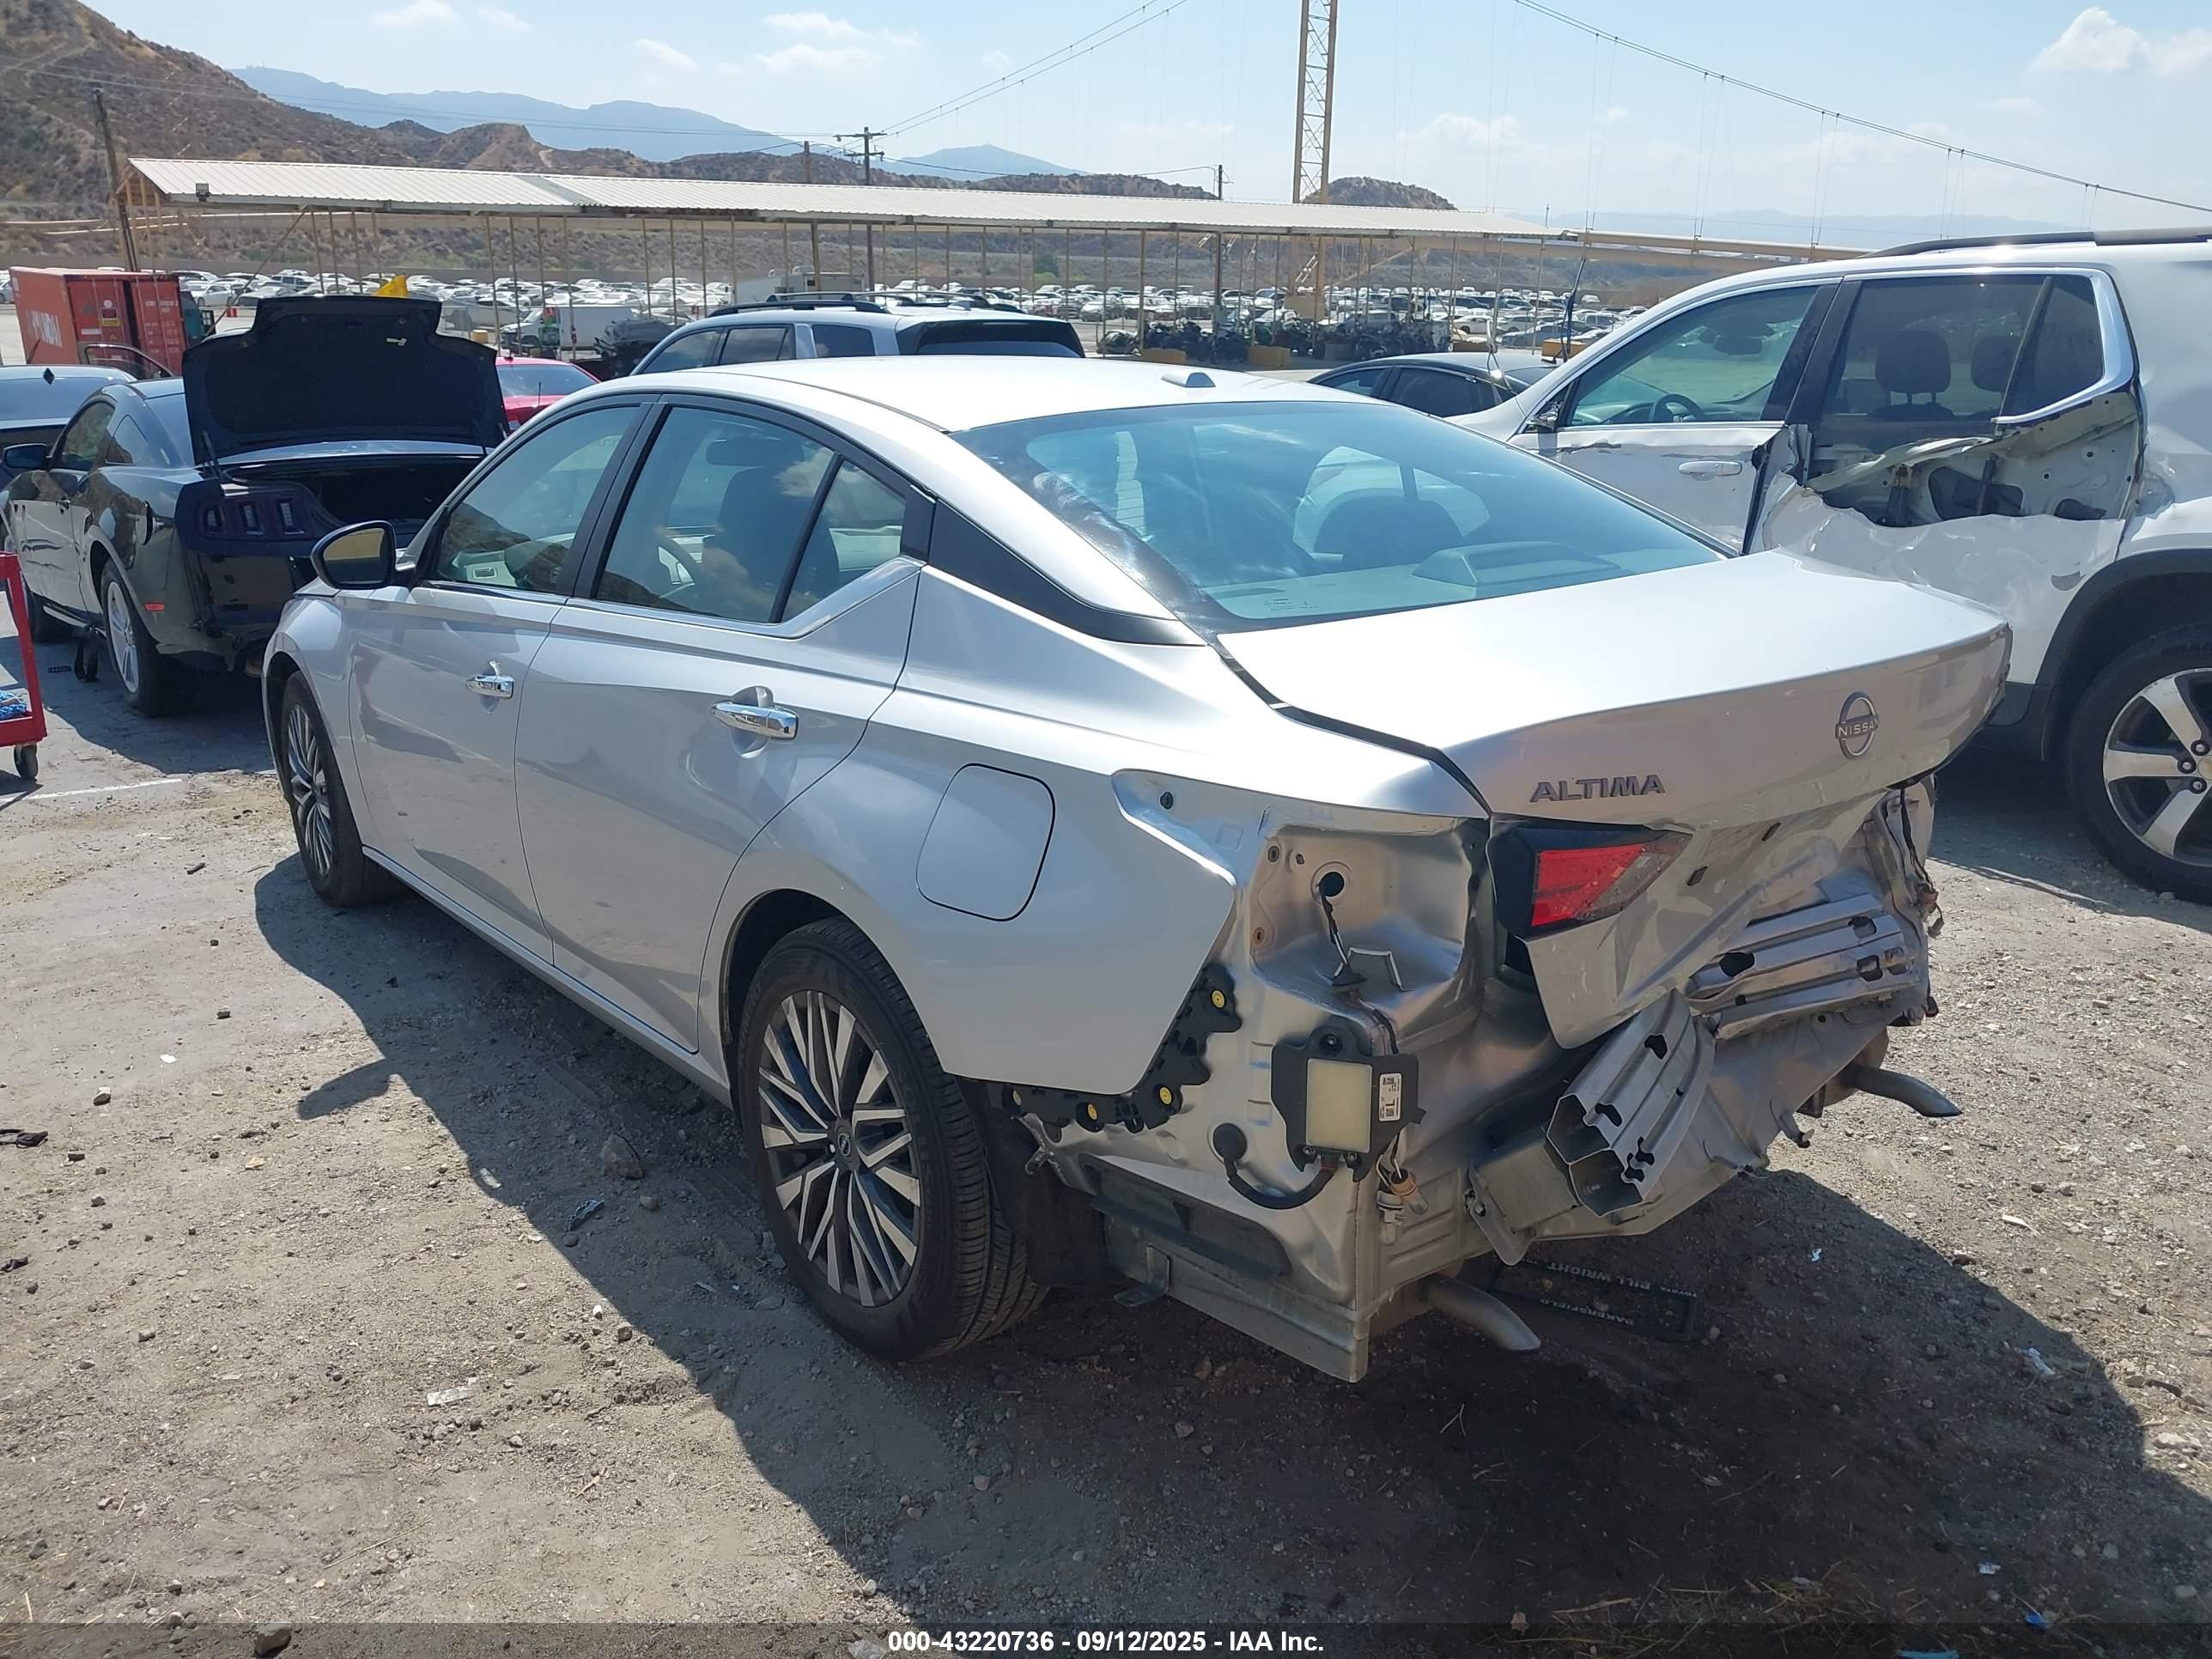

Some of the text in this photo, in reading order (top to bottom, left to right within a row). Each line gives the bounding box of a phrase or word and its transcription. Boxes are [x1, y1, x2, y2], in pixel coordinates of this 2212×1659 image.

[1529, 775, 1667, 803] ALTIMA
[1546, 1262, 1612, 1282] WRIGHT
[1660, 1285, 1698, 1297] TOYOTA
[1539, 1298, 1635, 1326] BAKERSFIELD
